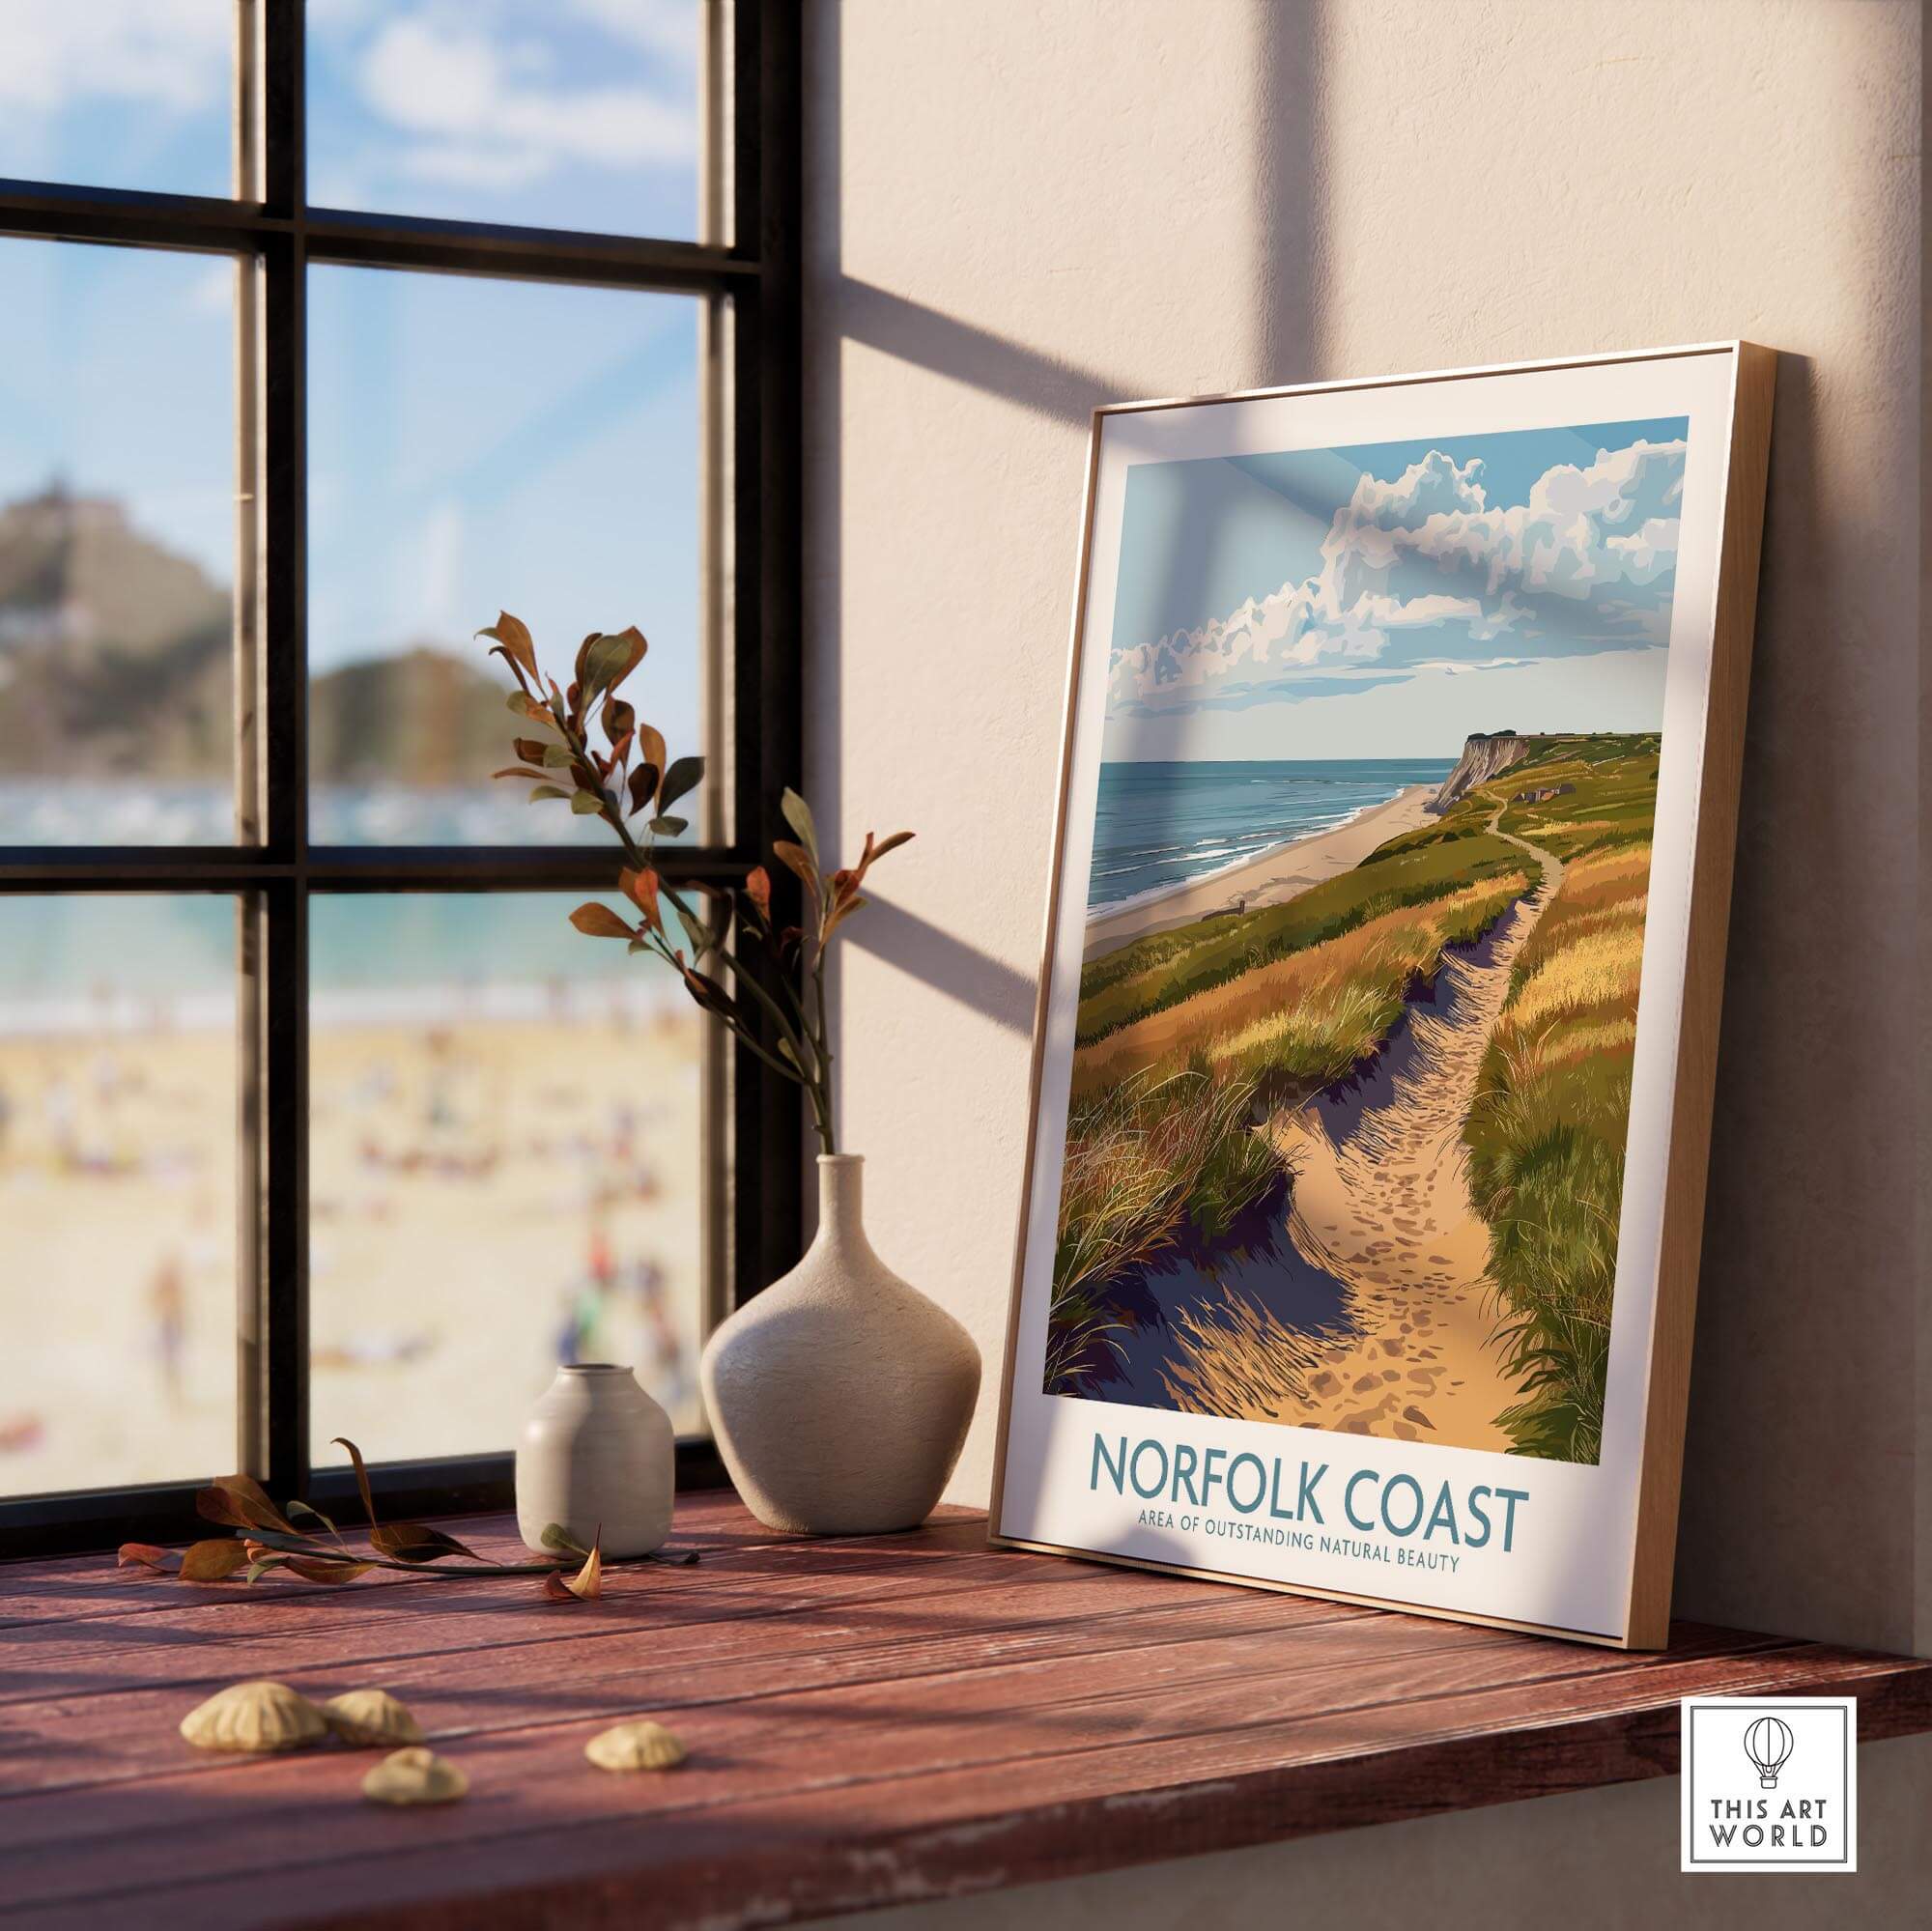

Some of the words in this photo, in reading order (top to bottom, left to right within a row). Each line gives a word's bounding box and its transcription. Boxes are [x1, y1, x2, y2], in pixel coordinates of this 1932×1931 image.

[1090, 1433, 1329, 1525] NORFOLK
[1344, 1469, 1530, 1553] COAST
[1138, 1509, 1175, 1529] AREA
[1180, 1515, 1200, 1532] OF
[1205, 1519, 1314, 1551] OUTSTANDING
[1320, 1536, 1391, 1564] NATURAL
[1397, 1548, 1461, 1574] BEAUTY
